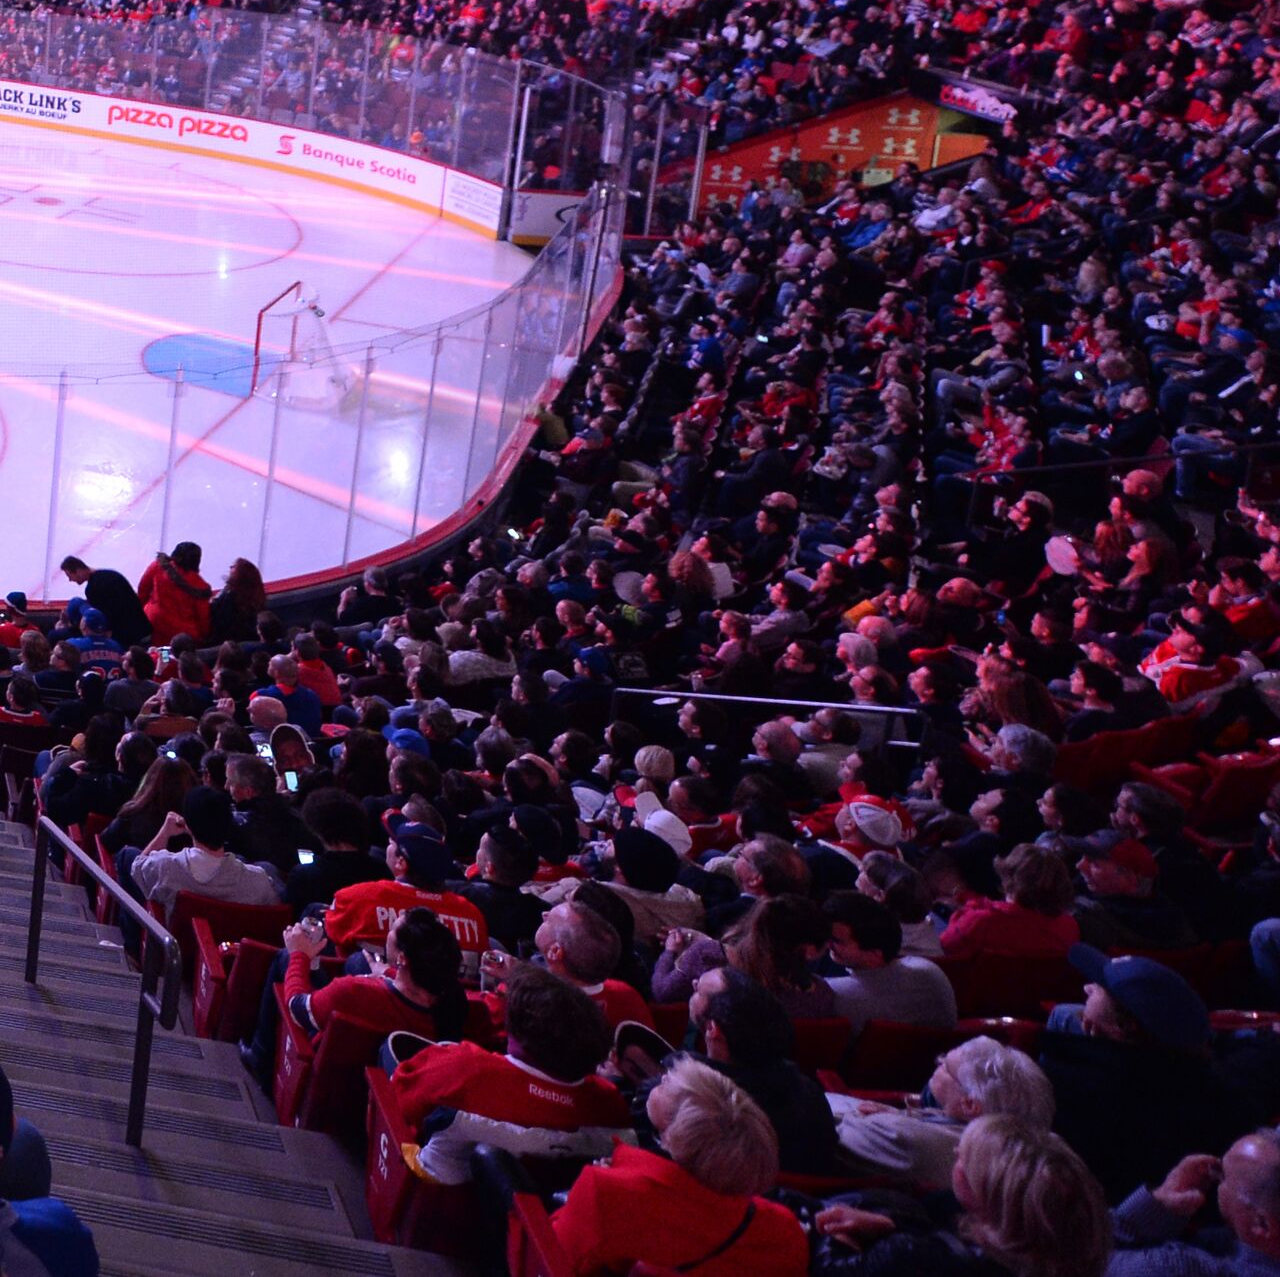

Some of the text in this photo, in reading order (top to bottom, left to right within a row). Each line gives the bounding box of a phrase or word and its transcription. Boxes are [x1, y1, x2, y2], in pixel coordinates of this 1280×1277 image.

[28, 92, 83, 115] LINK'S
[107, 104, 249, 143] pizza pizza
[302, 142, 417, 185] Banque Scotia
[528, 1082, 574, 1107] Reebok
